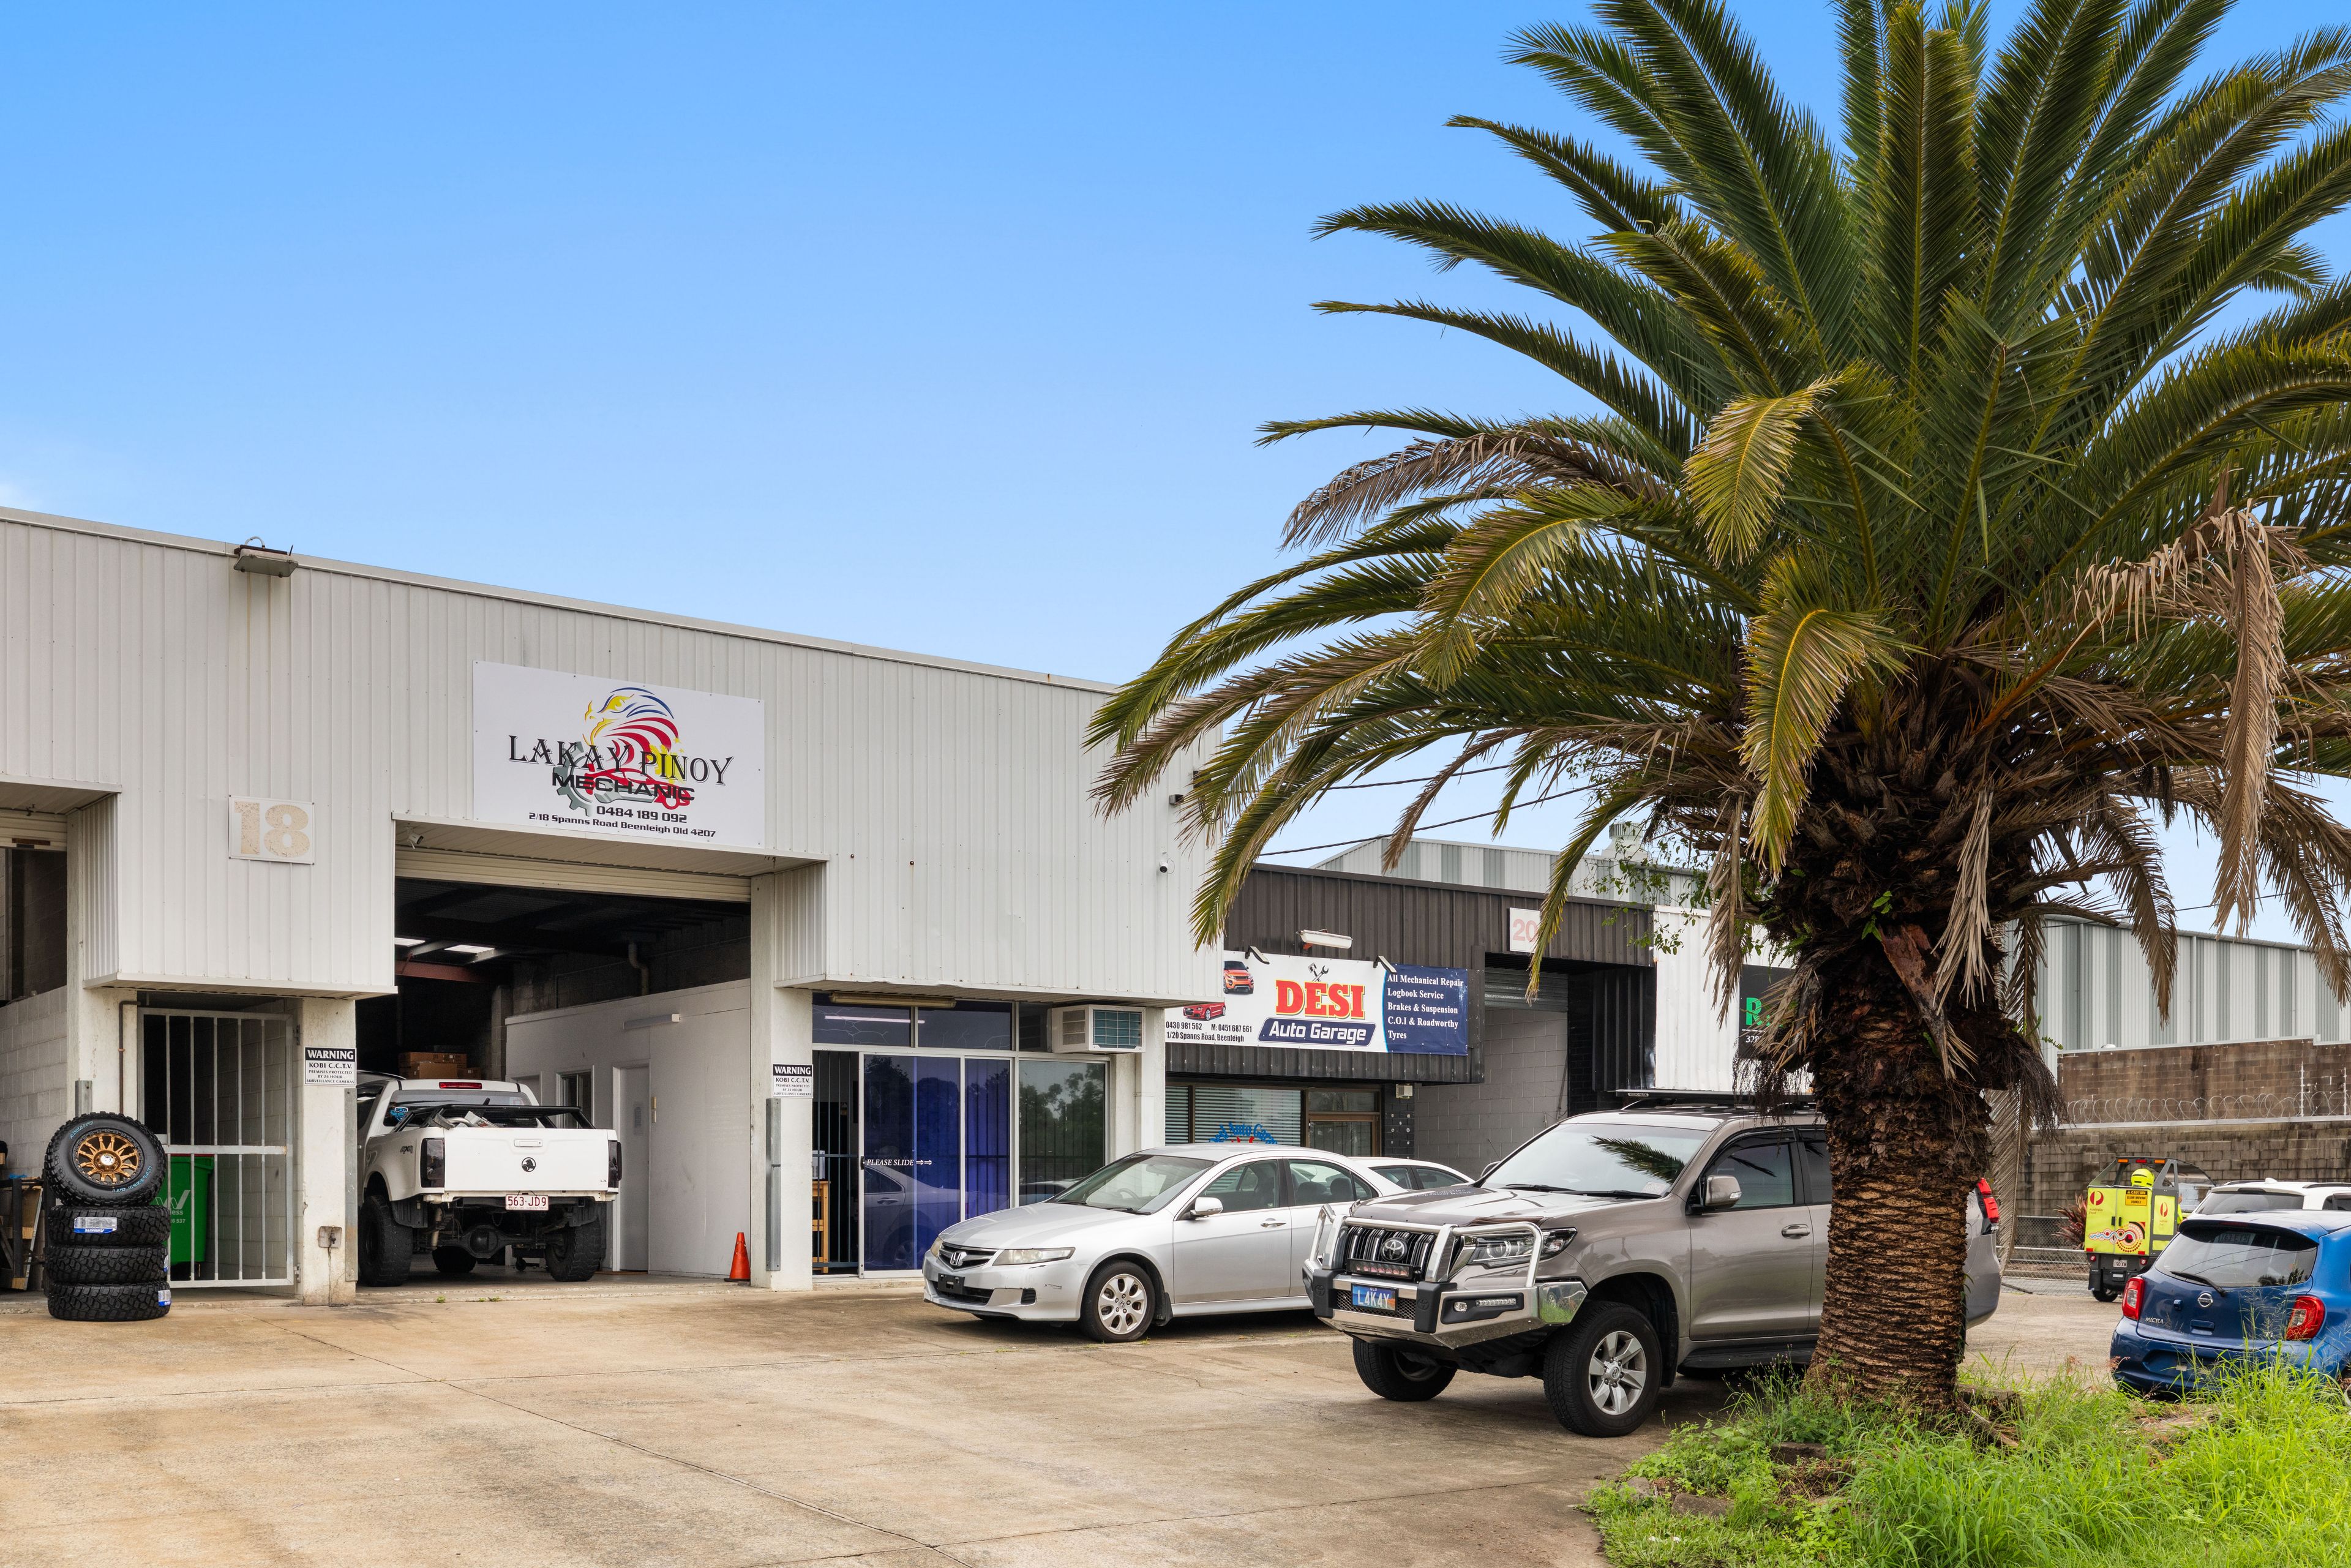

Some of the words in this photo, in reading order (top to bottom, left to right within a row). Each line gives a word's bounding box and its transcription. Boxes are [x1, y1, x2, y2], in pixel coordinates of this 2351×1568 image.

[509, 735, 631, 773] LAKAY
[639, 751, 734, 786] PINOY
[552, 772, 695, 800] MECHANIC
[529, 812, 549, 821] 2/18
[552, 815, 590, 825] Spanns
[593, 819, 618, 828] Road
[621, 822, 670, 834] Beenleigh
[596, 806, 633, 817] 0484
[637, 810, 658, 820] 189
[662, 812, 687, 823] 092
[234, 801, 310, 857] 18
[1512, 918, 1538, 942] 20
[1400, 975, 1439, 985] Mechanical
[1441, 978, 1464, 988] Repair
[1276, 980, 1365, 1019] DESI
[1387, 988, 1418, 998] Logbook
[1419, 990, 1444, 999] Service
[1387, 1002, 1411, 1011] Brakes
[1413, 1003, 1420, 1012] &
[1421, 1004, 1458, 1015] Suspension
[1387, 1016, 1407, 1025] C.O.I
[1409, 1017, 1415, 1026] &
[1417, 1018, 1458, 1029] Roadworthy
[1217, 1034, 1244, 1043] Beenleigh
[1269, 1021, 1307, 1038] Auto
[1310, 1023, 1367, 1045] Garage
[1387, 1030, 1407, 1040] Tyres
[307, 1049, 354, 1060] WARNING
[774, 1066, 811, 1075] WARNING
[1358, 1289, 1389, 1308] L4K4Y
